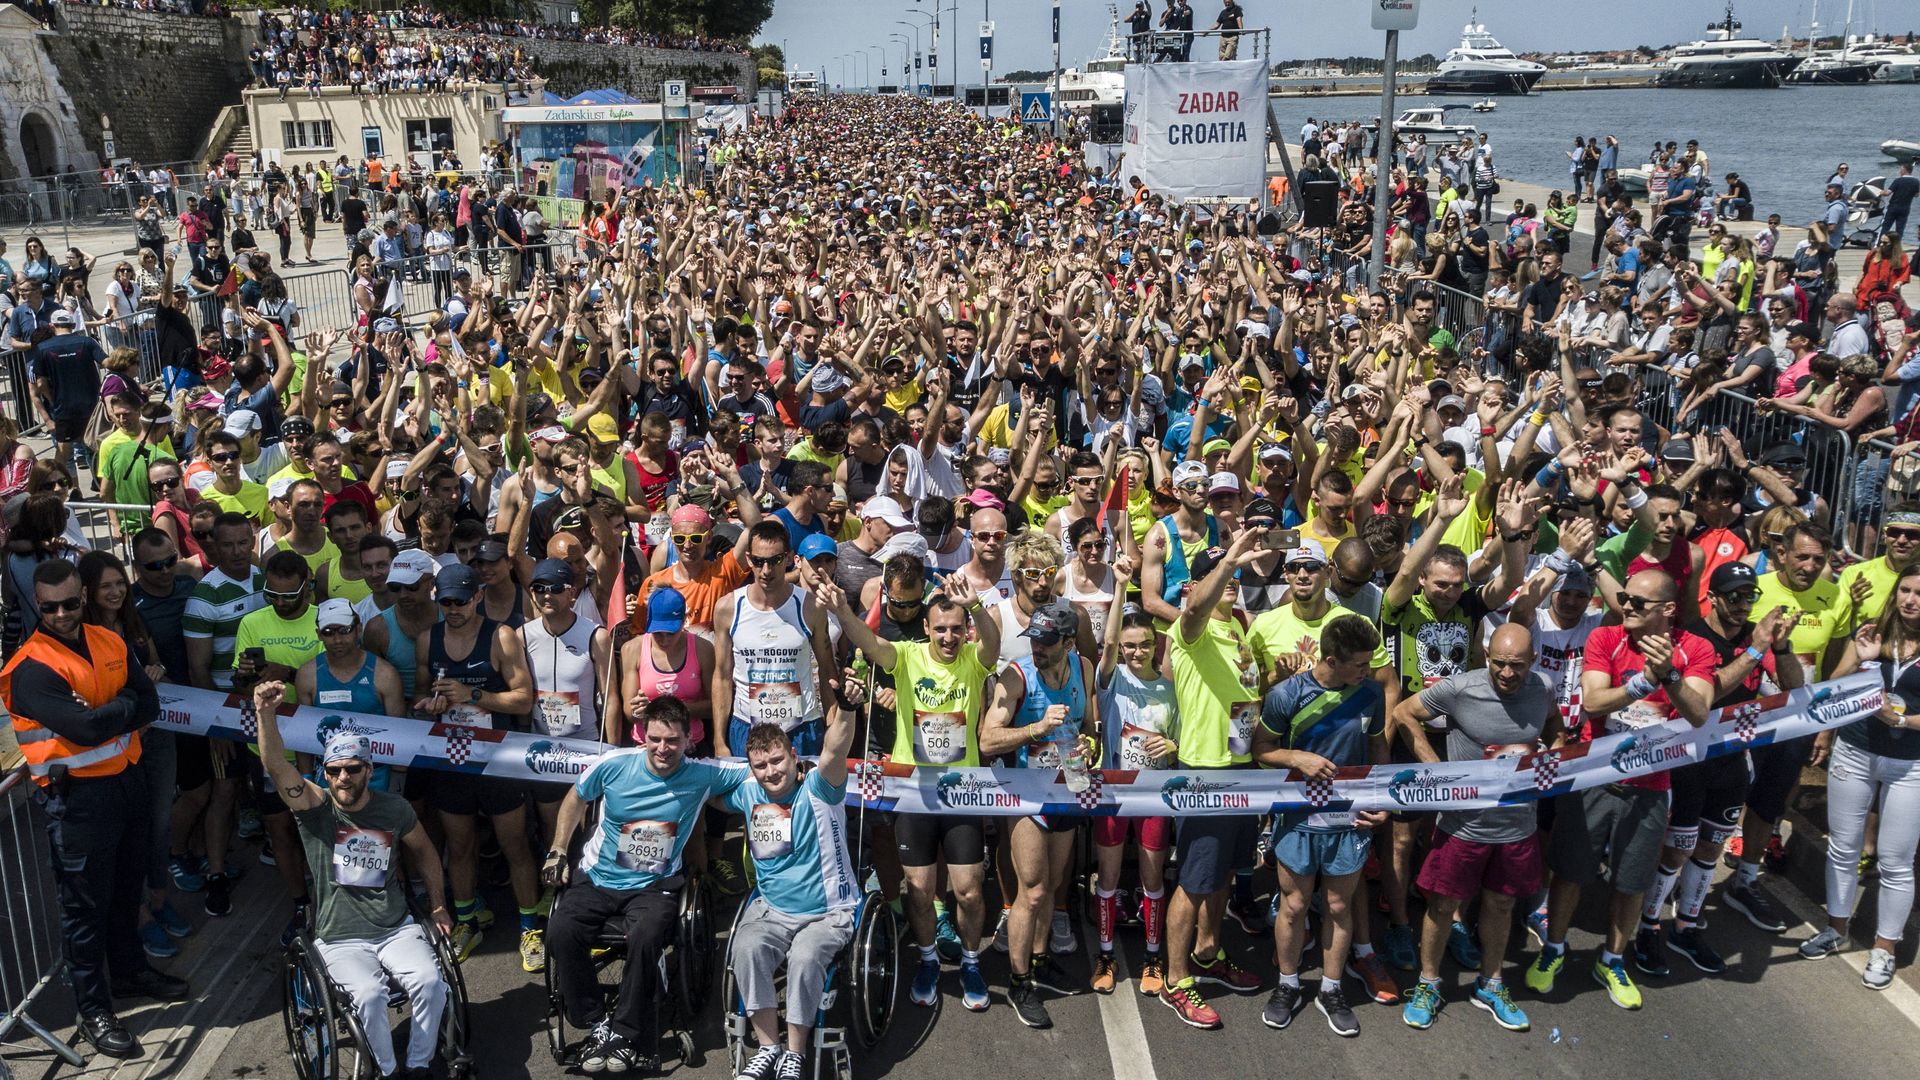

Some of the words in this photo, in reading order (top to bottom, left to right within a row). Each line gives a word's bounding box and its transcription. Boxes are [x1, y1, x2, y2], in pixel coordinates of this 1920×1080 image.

[983, 43, 988, 53] 2
[1178, 91, 1239, 114] ZADAR
[1169, 121, 1247, 145] CROATIA
[1808, 619, 1823, 627] RUN
[260, 635, 307, 646] saucony
[759, 648, 802, 656] "ROGOVO"
[949, 687, 967, 701] RUN
[758, 707, 793, 719] 19491
[1820, 700, 1860, 720] WORLD
[1860, 694, 1883, 712] RUN
[168, 710, 190, 725] RUN
[541, 713, 567, 724] 8147
[371, 741, 394, 756] RUN
[927, 737, 950, 749] 506
[1123, 749, 1158, 769] 36339
[1623, 749, 1664, 770] WORLD
[1664, 743, 1688, 760] RUN
[538, 760, 580, 775] WORLD
[951, 792, 994, 807] WORLD
[996, 793, 1020, 807] RUN
[1176, 794, 1220, 808] WORLD
[1223, 793, 1249, 808] RUN
[1403, 788, 1450, 802] WORLD
[1452, 786, 1478, 800] RUN
[753, 829, 782, 842] 90618
[627, 843, 664, 858] 26931
[831, 819, 847, 882] BAUERFEIND
[342, 854, 382, 870] 91150
